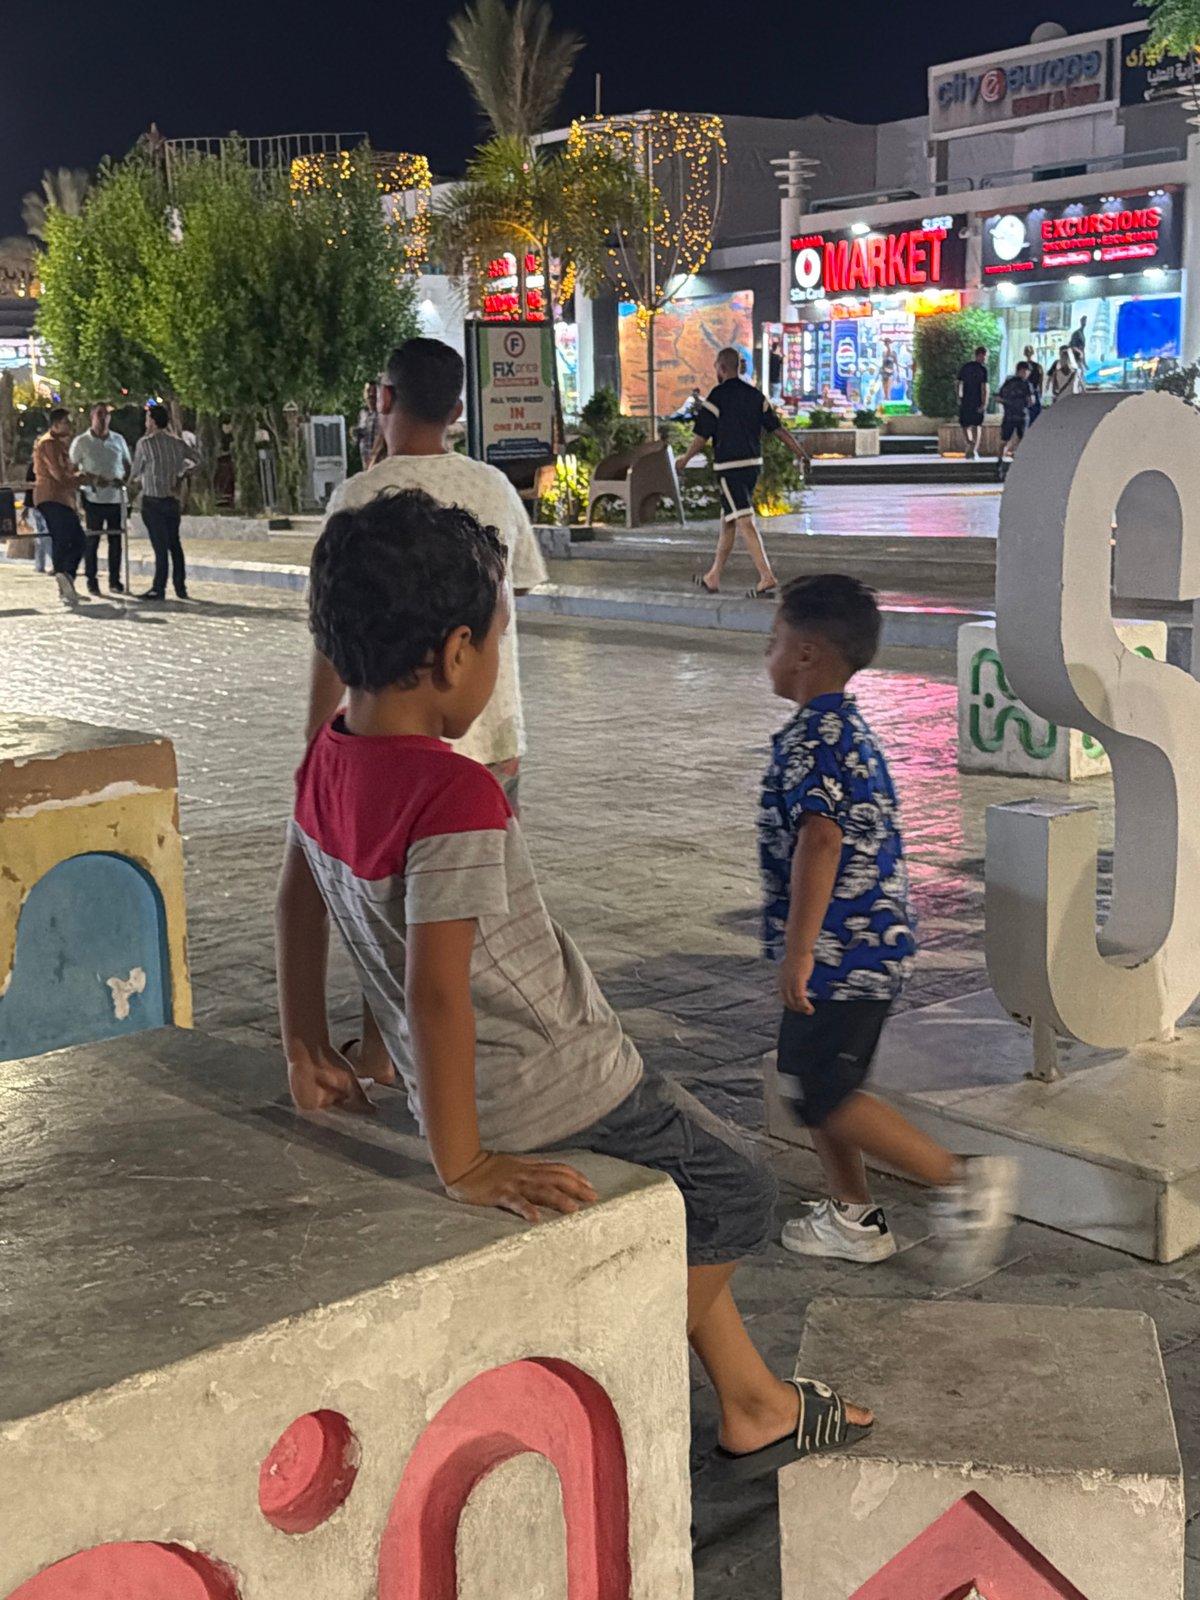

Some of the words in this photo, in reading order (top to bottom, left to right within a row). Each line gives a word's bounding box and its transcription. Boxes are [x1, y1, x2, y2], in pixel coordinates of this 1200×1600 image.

[921, 215, 954, 232] SUPER
[1041, 206, 1162, 240] EXCURSIONS
[822, 228, 948, 292] MARKET
[507, 396, 522, 404] YOU
[523, 395, 543, 403] NEED
[510, 406, 525, 419] IN
[493, 423, 512, 432] ONE
[514, 422, 541, 432] PLACE
